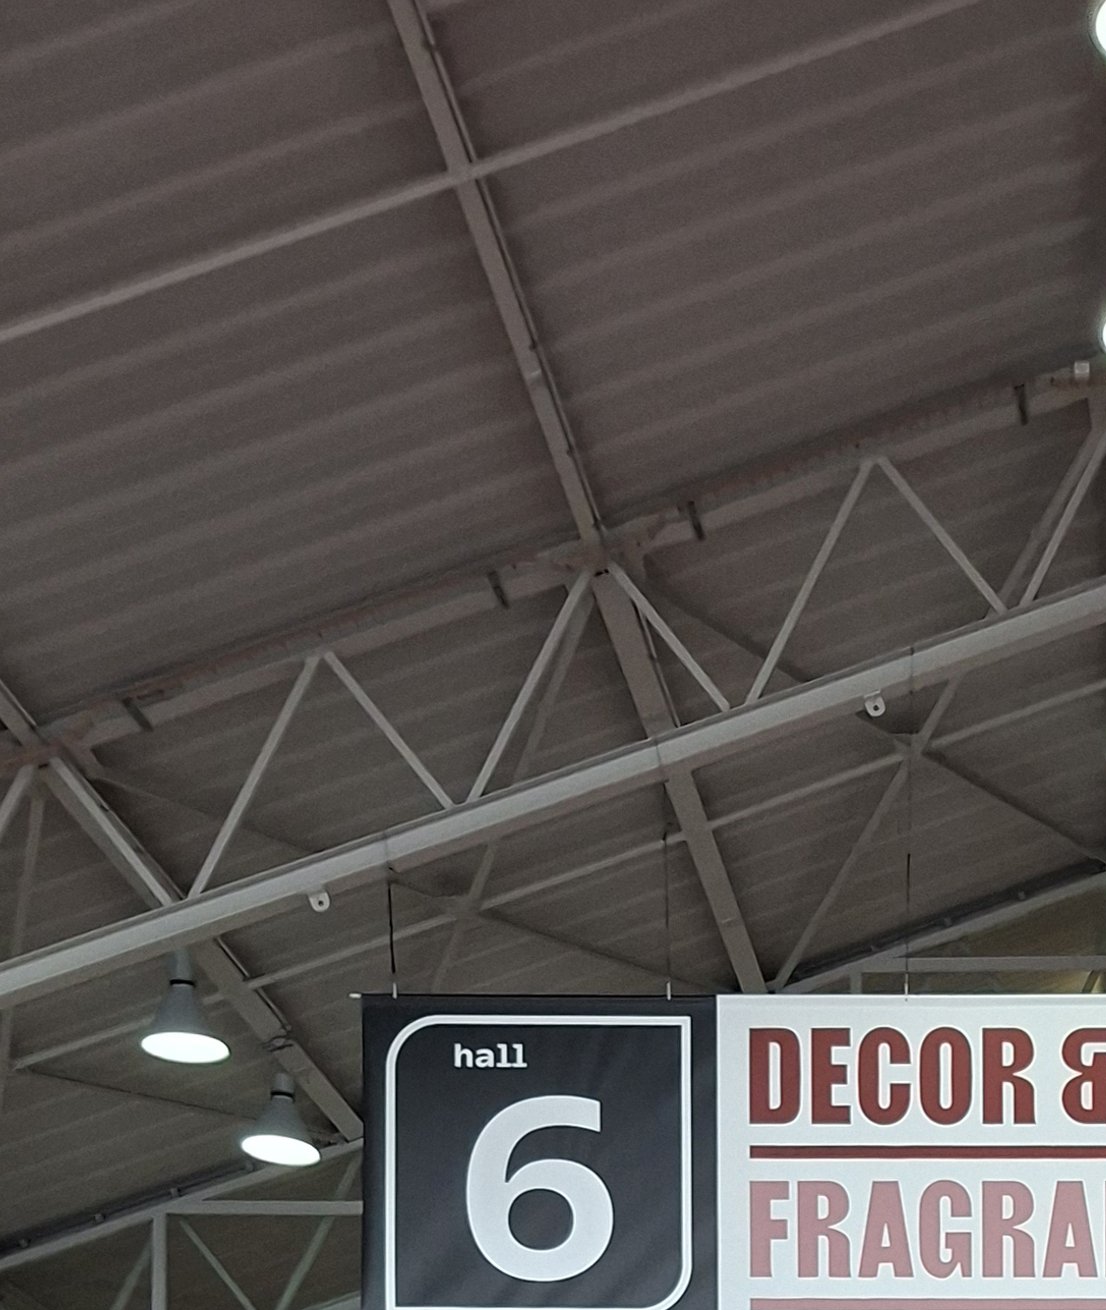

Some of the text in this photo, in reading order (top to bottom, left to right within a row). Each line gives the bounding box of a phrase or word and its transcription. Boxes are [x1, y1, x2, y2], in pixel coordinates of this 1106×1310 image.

[453, 1043, 528, 1068] hall
[749, 1026, 1037, 1126] DECOR
[466, 1094, 614, 1282] 6
